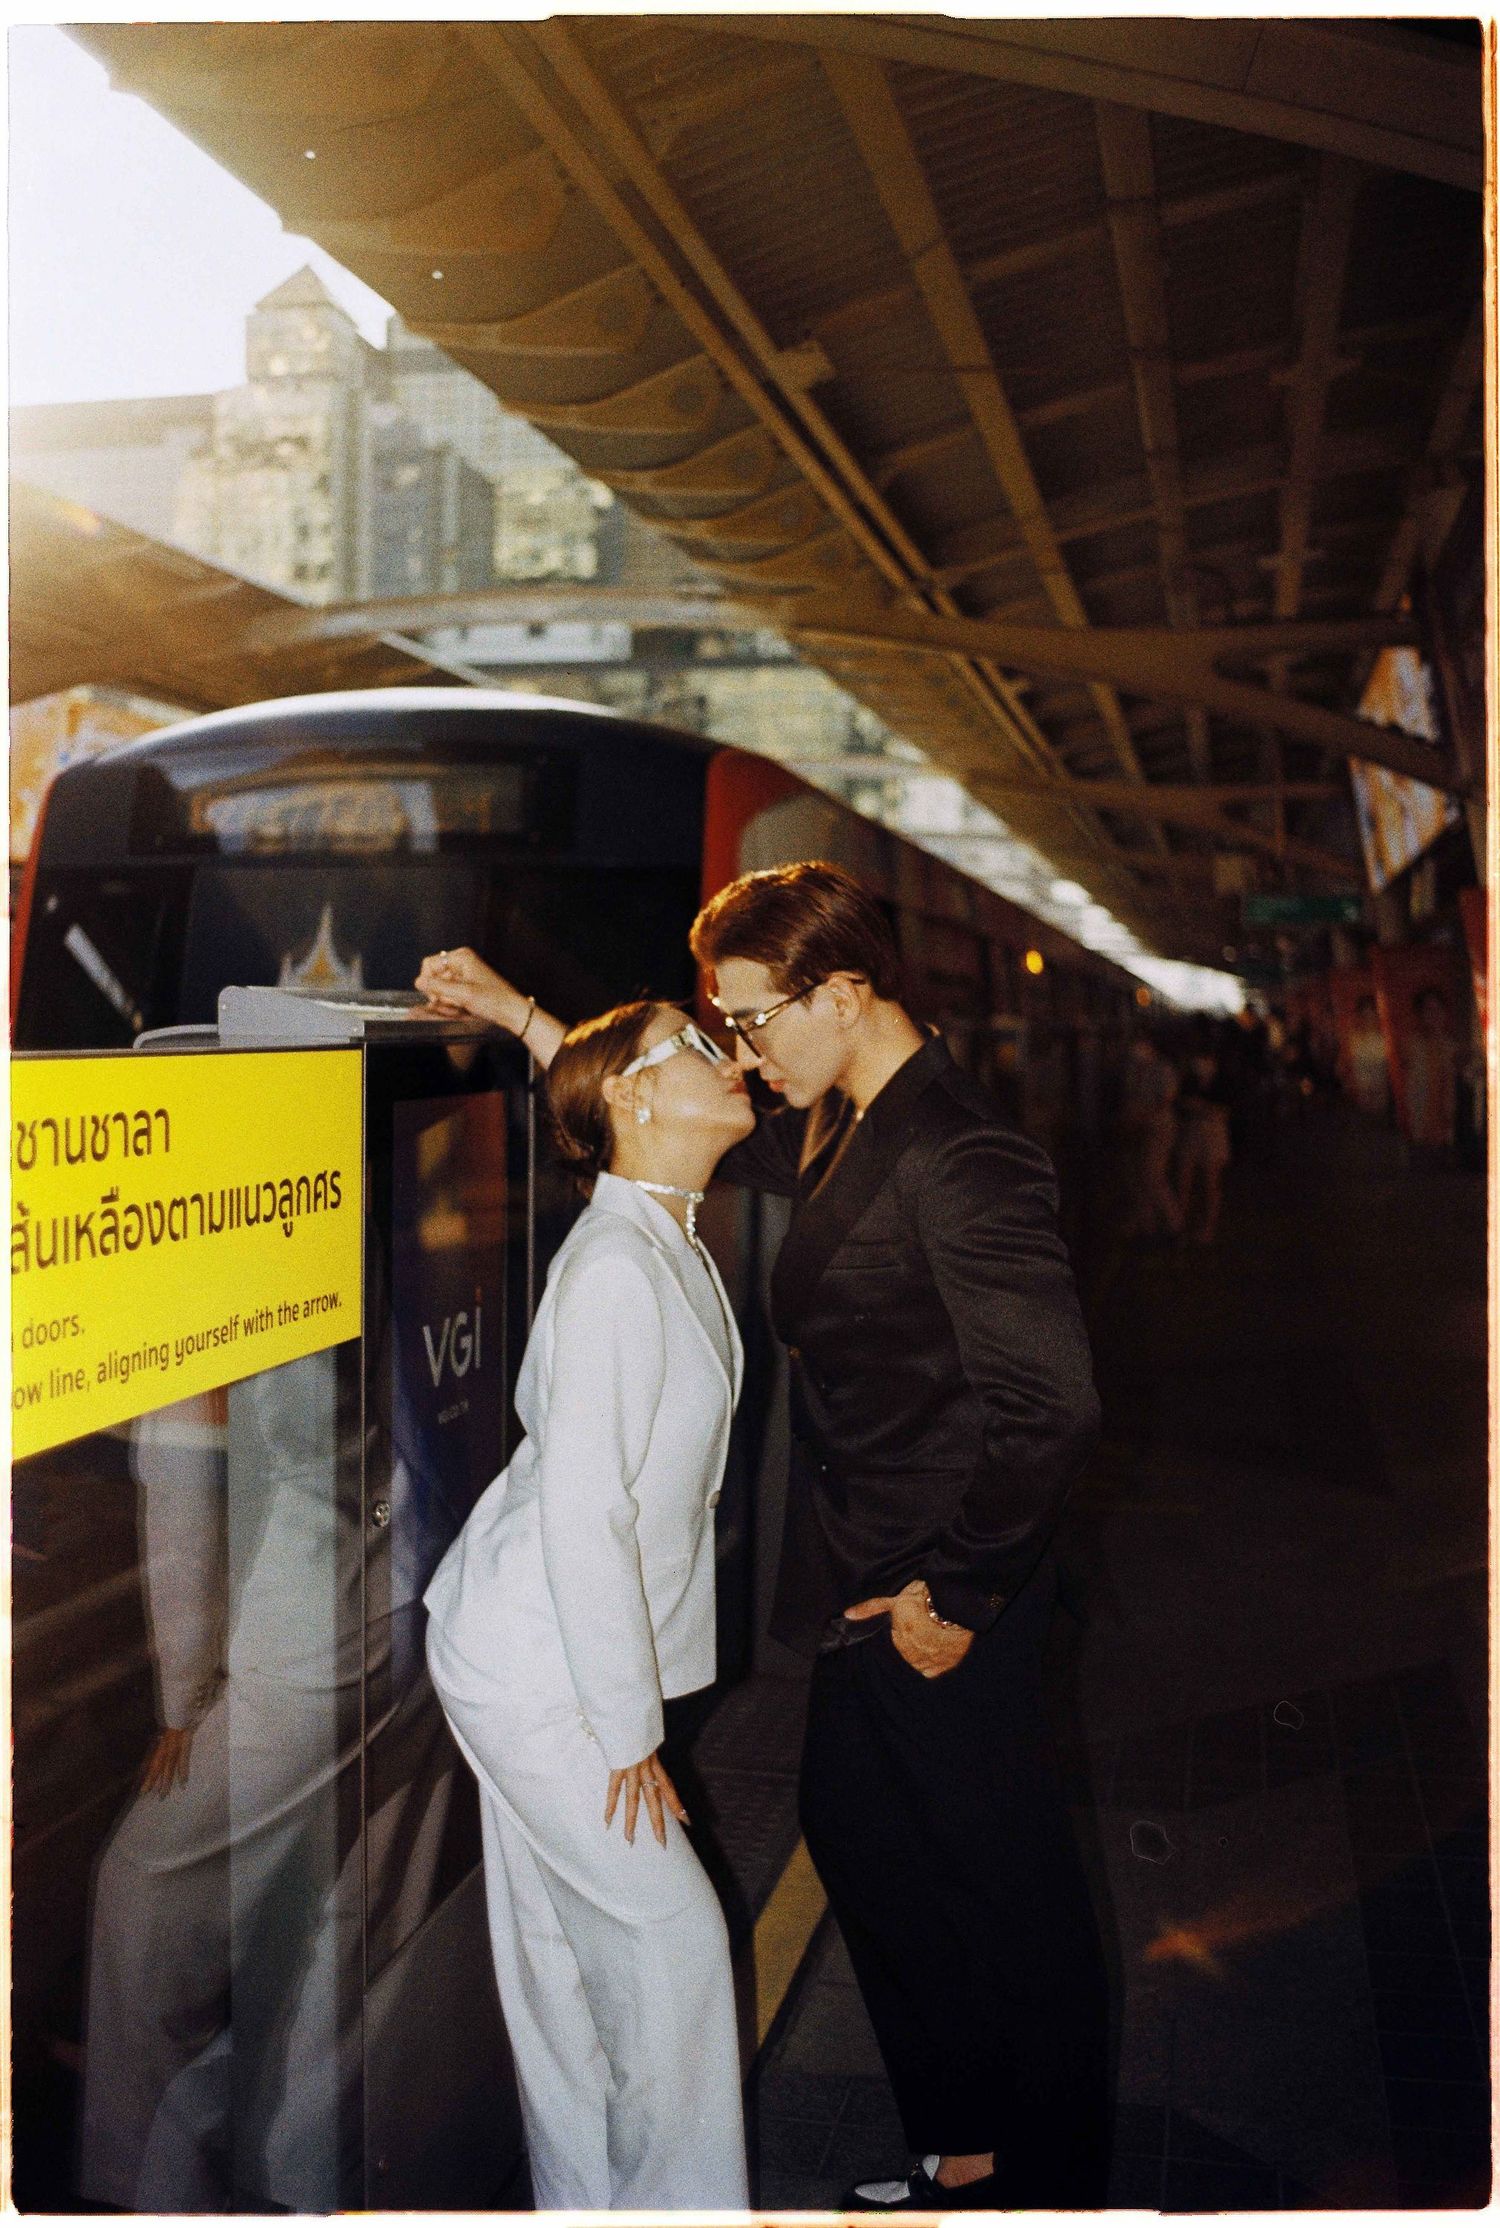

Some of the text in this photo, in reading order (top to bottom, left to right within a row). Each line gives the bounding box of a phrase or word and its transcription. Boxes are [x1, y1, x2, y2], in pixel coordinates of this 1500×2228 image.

[16, 1108, 170, 1171] ชานชาลา
[22, 1314, 86, 1349] doors.
[49, 1367, 91, 1399] line,
[96, 1342, 170, 1385] aligning
[174, 1314, 240, 1366] yourself
[243, 1306, 274, 1337] with
[277, 1300, 300, 1326] the
[303, 1291, 342, 1318] arrow.
[423, 1300, 481, 1386] VGI
